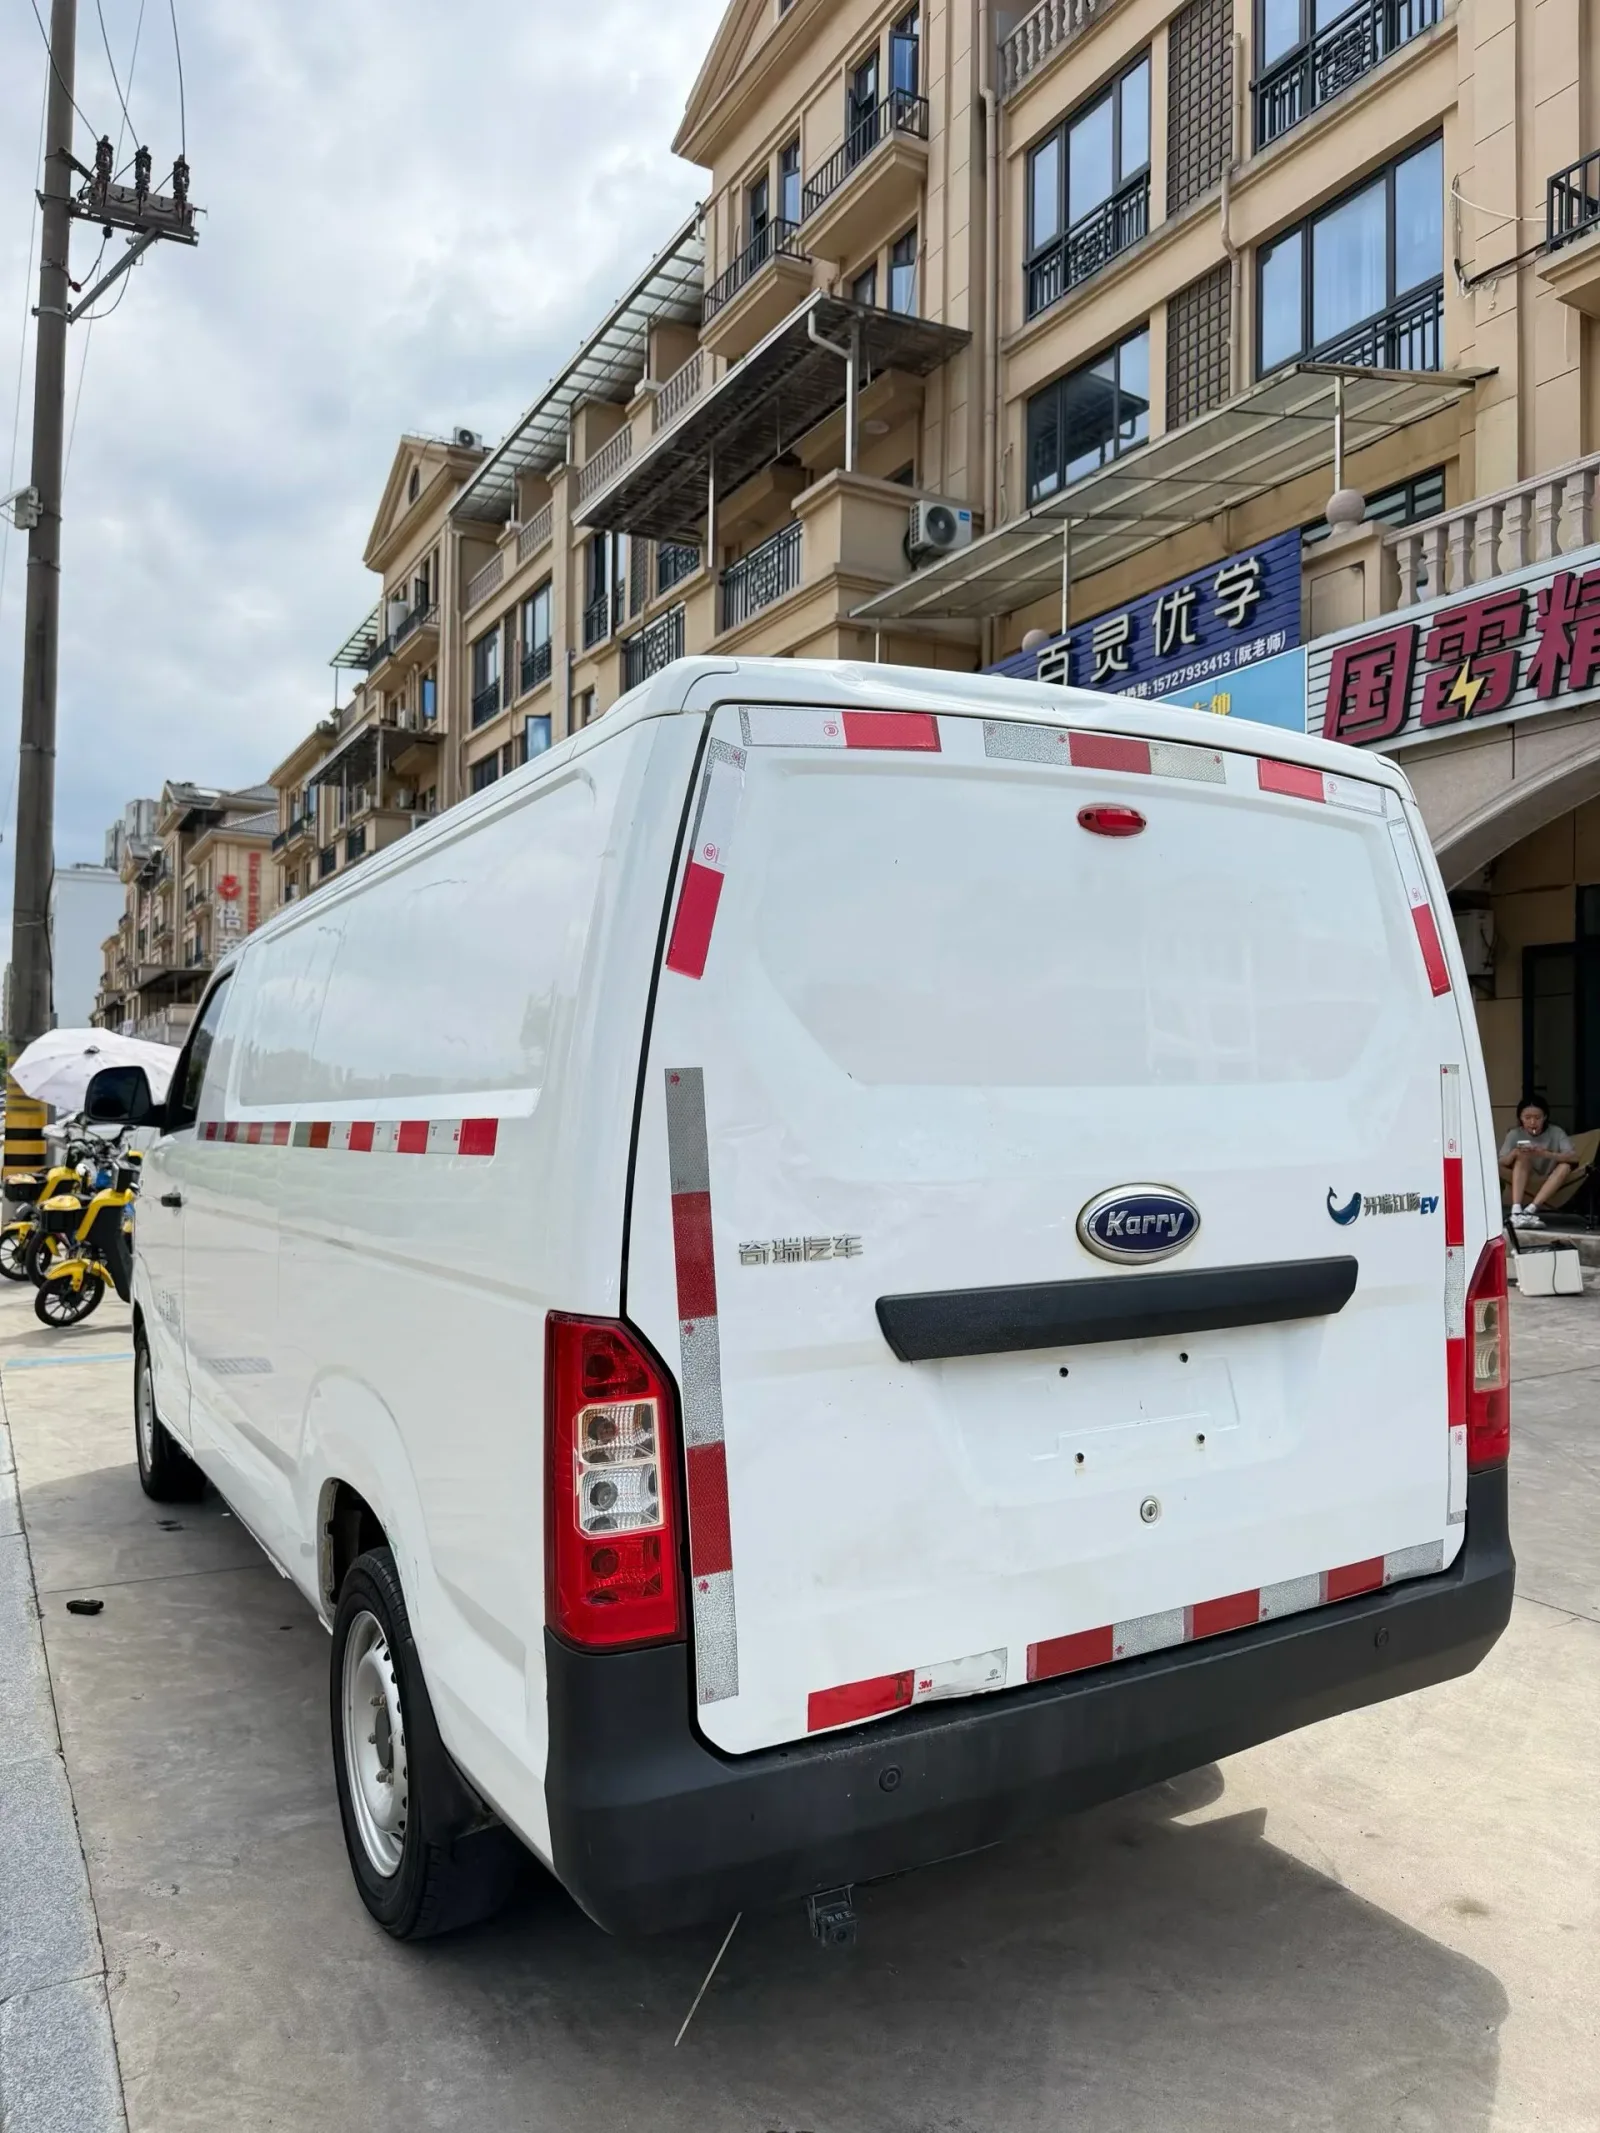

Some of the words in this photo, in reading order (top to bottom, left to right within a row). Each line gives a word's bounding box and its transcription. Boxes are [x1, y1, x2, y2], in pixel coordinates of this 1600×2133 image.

[1037, 556, 1260, 685] 百灵优学
[1106, 1210, 1185, 1237] Karry
[738, 1233, 863, 1265] 奇瑞汽车
